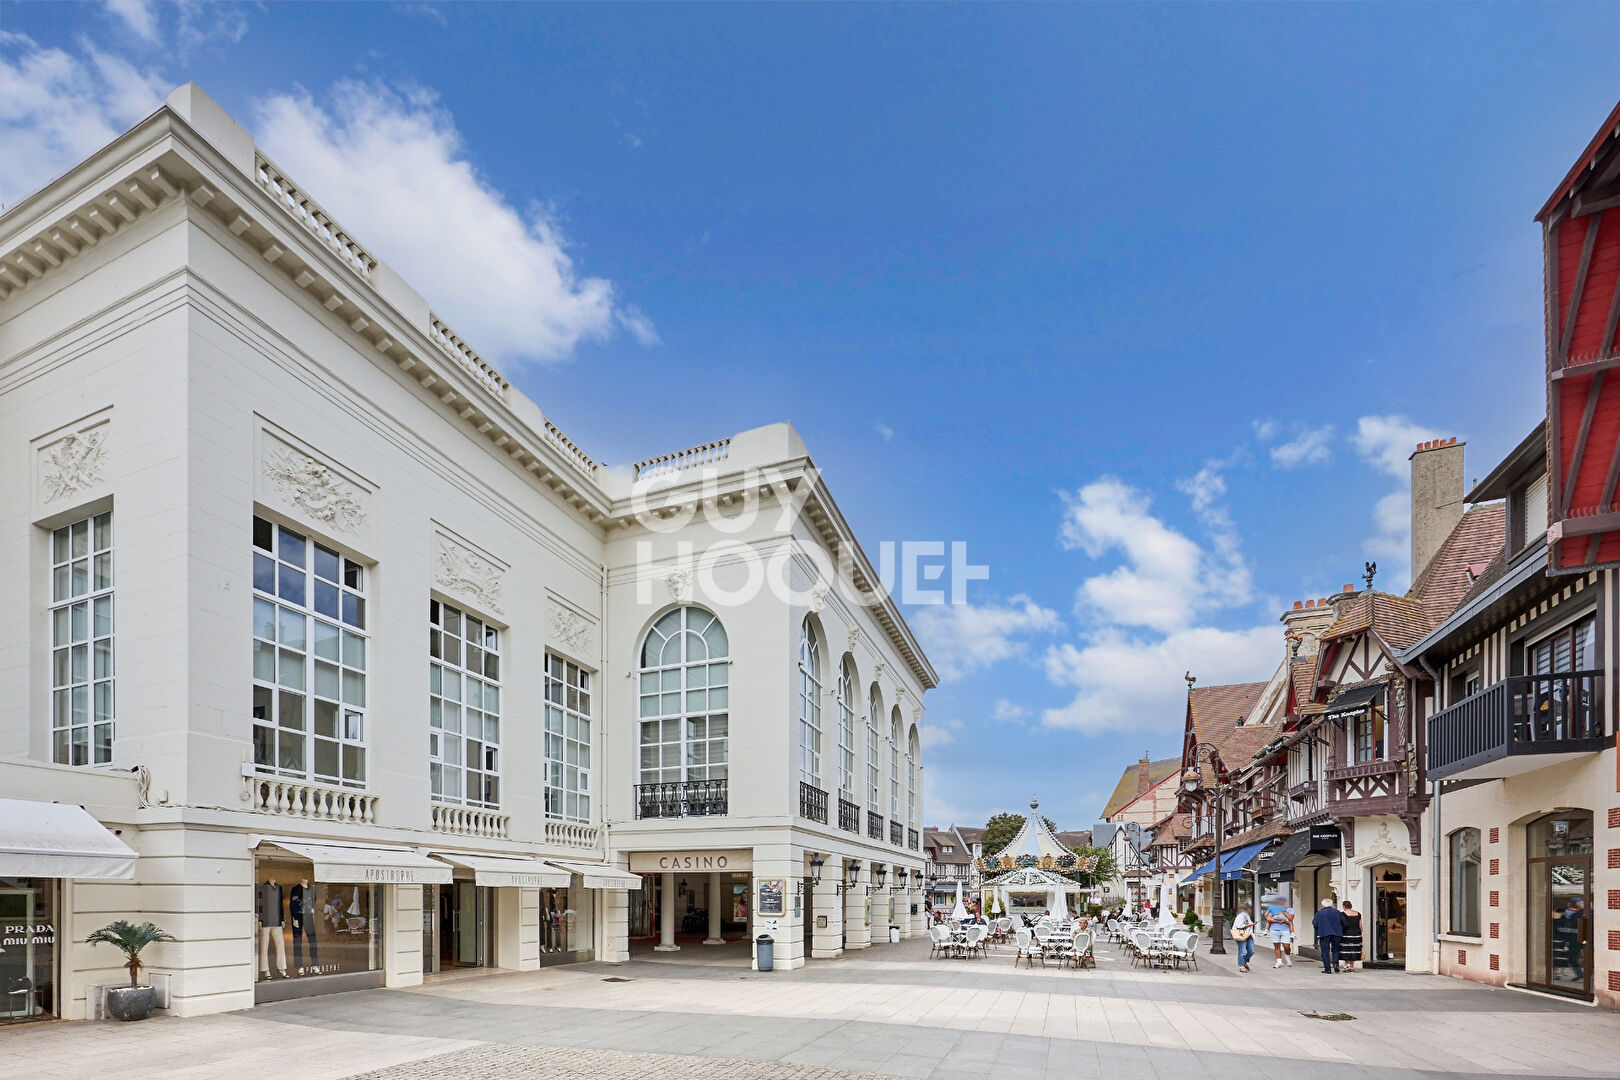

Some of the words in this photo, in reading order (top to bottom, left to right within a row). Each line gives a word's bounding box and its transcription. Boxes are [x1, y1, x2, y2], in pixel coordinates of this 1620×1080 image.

[659, 856, 728, 869] CASINO
[364, 868, 415, 882] APOSTROPHE
[5, 924, 54, 934] PRADA
